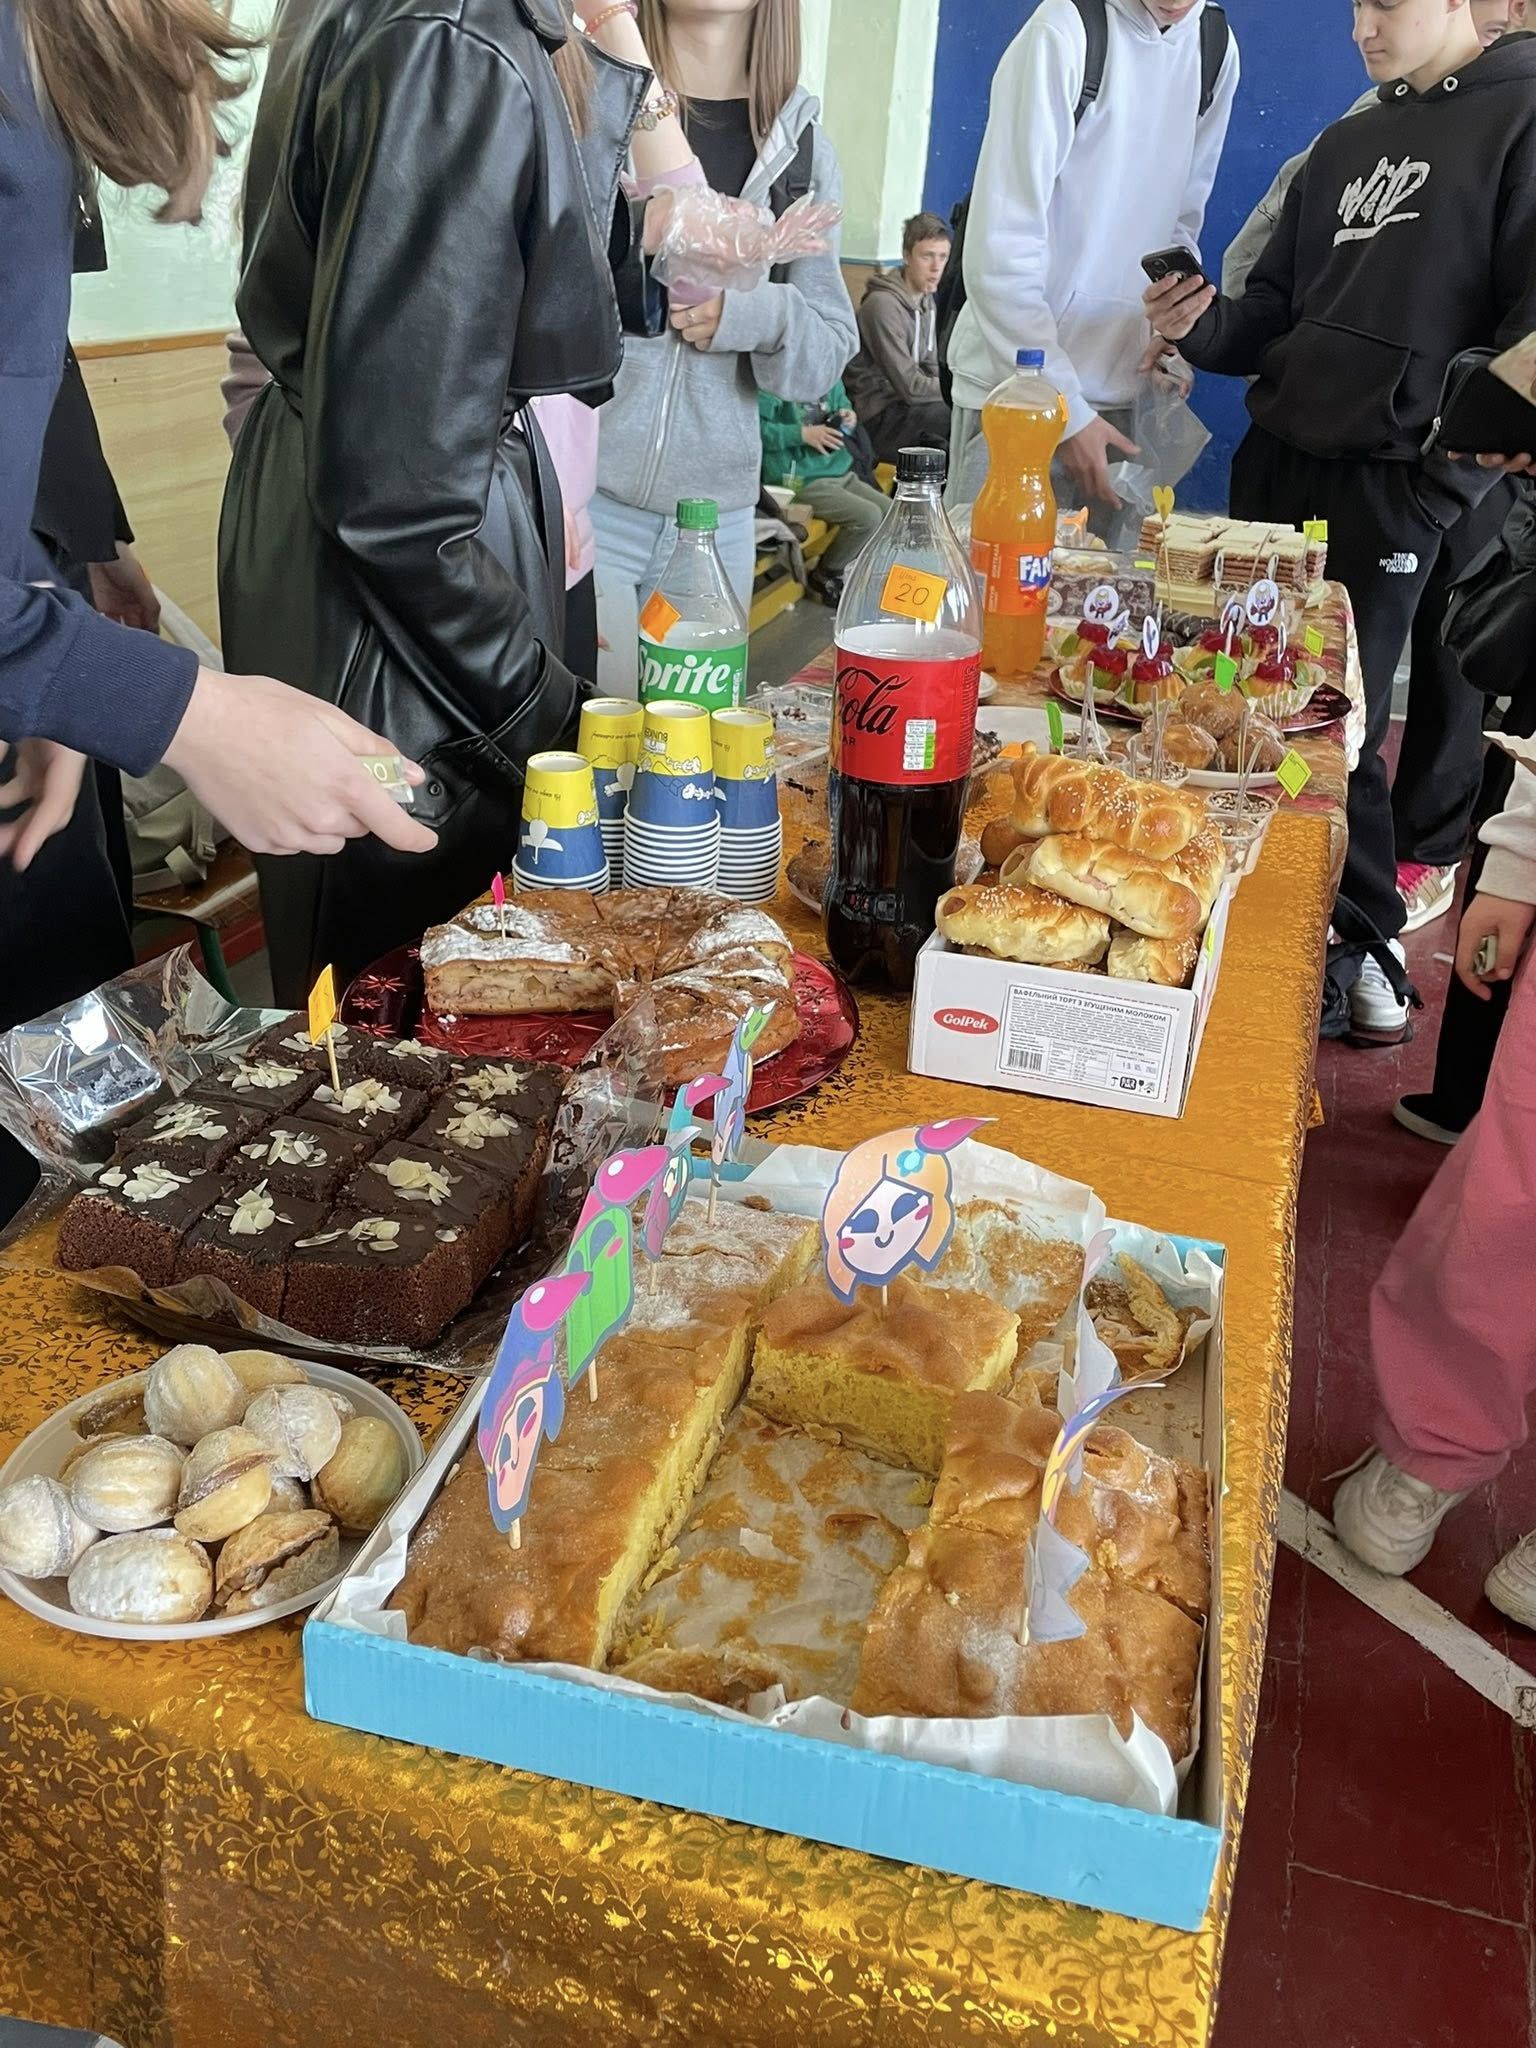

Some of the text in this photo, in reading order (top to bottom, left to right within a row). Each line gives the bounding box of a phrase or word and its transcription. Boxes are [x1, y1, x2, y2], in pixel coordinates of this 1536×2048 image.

[1019, 554, 1050, 583] FAN
[894, 583, 930, 606] 20
[1013, 988, 1058, 1001] ВАФЕЛЬНИЙ
[1059, 995, 1077, 1005] ТОРТ
[1083, 1000, 1124, 1014] ЗГУЩЕНИМ
[1125, 1009, 1167, 1022] МОЛОКОМ
[943, 1013, 989, 1030] GolPek
